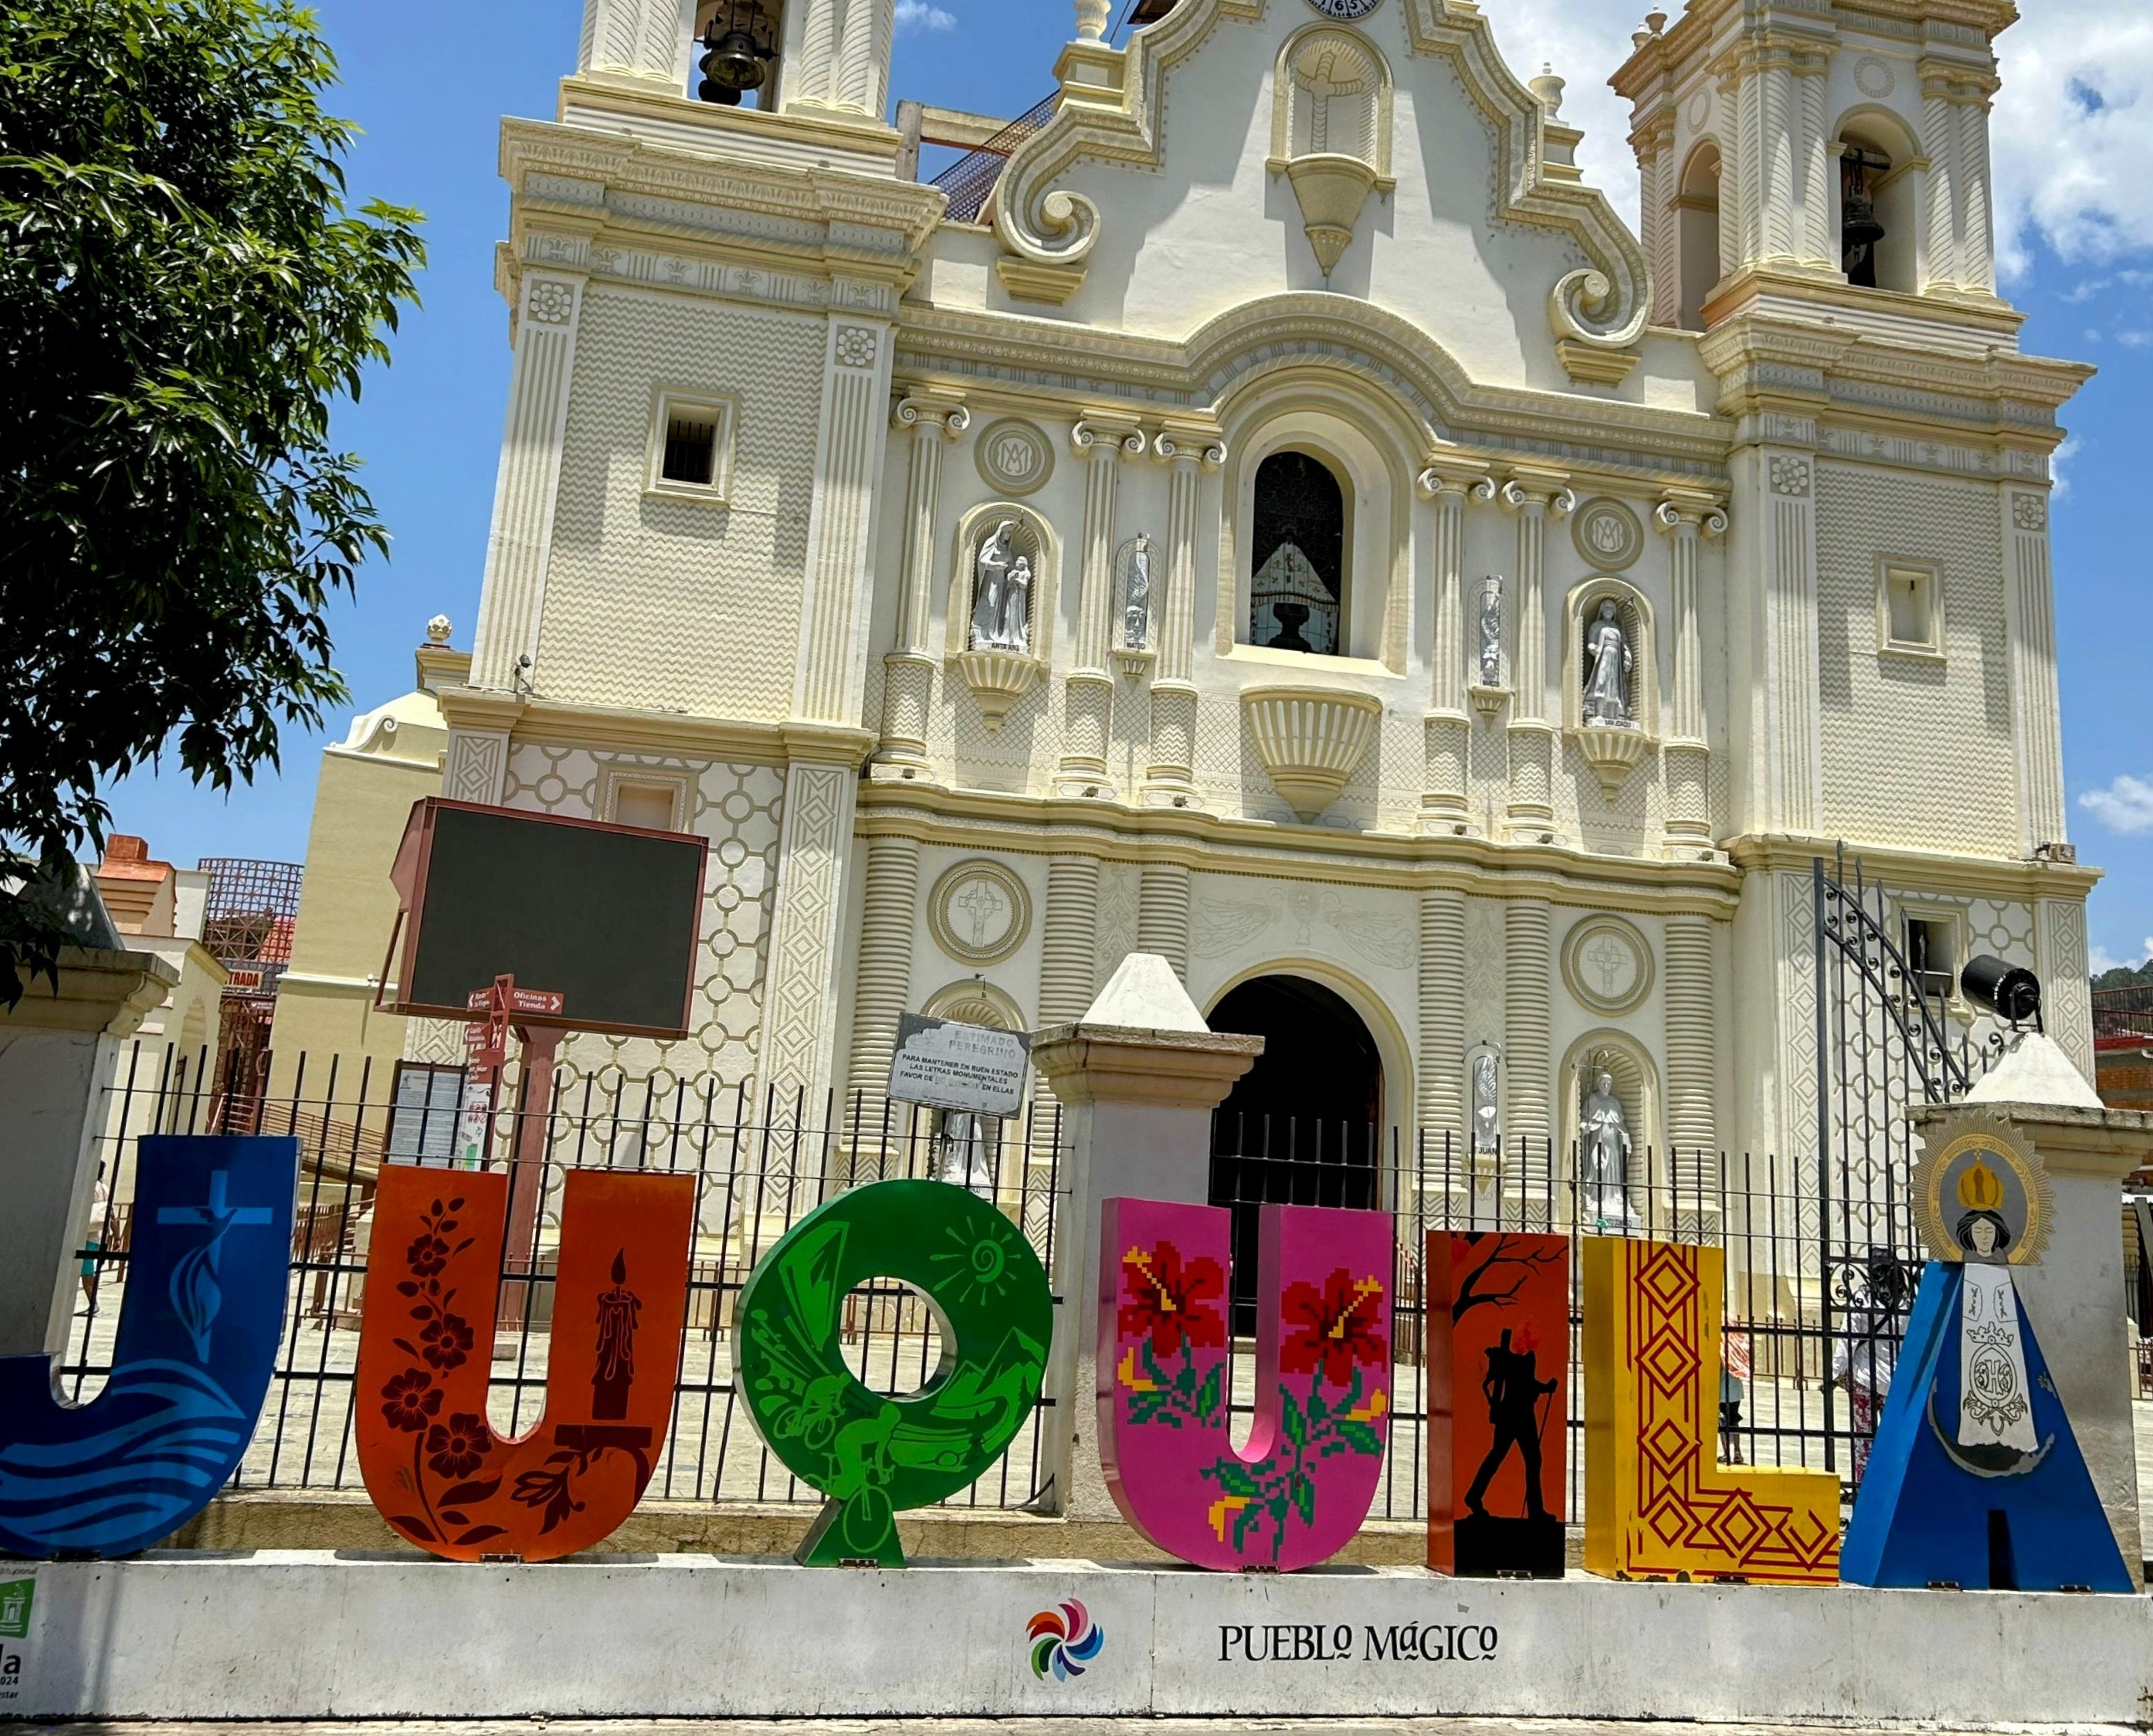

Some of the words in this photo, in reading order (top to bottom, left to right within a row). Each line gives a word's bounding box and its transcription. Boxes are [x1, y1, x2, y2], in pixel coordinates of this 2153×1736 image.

[514, 992, 547, 1002] Oficinas
[518, 1000, 546, 1010] Tienda
[948, 1040, 1016, 1059] PEREGRINO
[954, 1030, 1014, 1047] ESTIMADO
[902, 1053, 921, 1063] PARA
[921, 1057, 959, 1069] MANTENER
[971, 1065, 990, 1074] BUEN
[991, 1068, 1019, 1079] ESTADO
[910, 1063, 924, 1071] LAS
[924, 1065, 951, 1076] LETRAS
[952, 1070, 1008, 1085] MONUMENTALES
[900, 1070, 923, 1080] FAVOR
[992, 1085, 1015, 1095] ELLAS
[0, 1135, 2139, 1594] JUQUILA
[1218, 1624, 1352, 1662] PUEBLO
